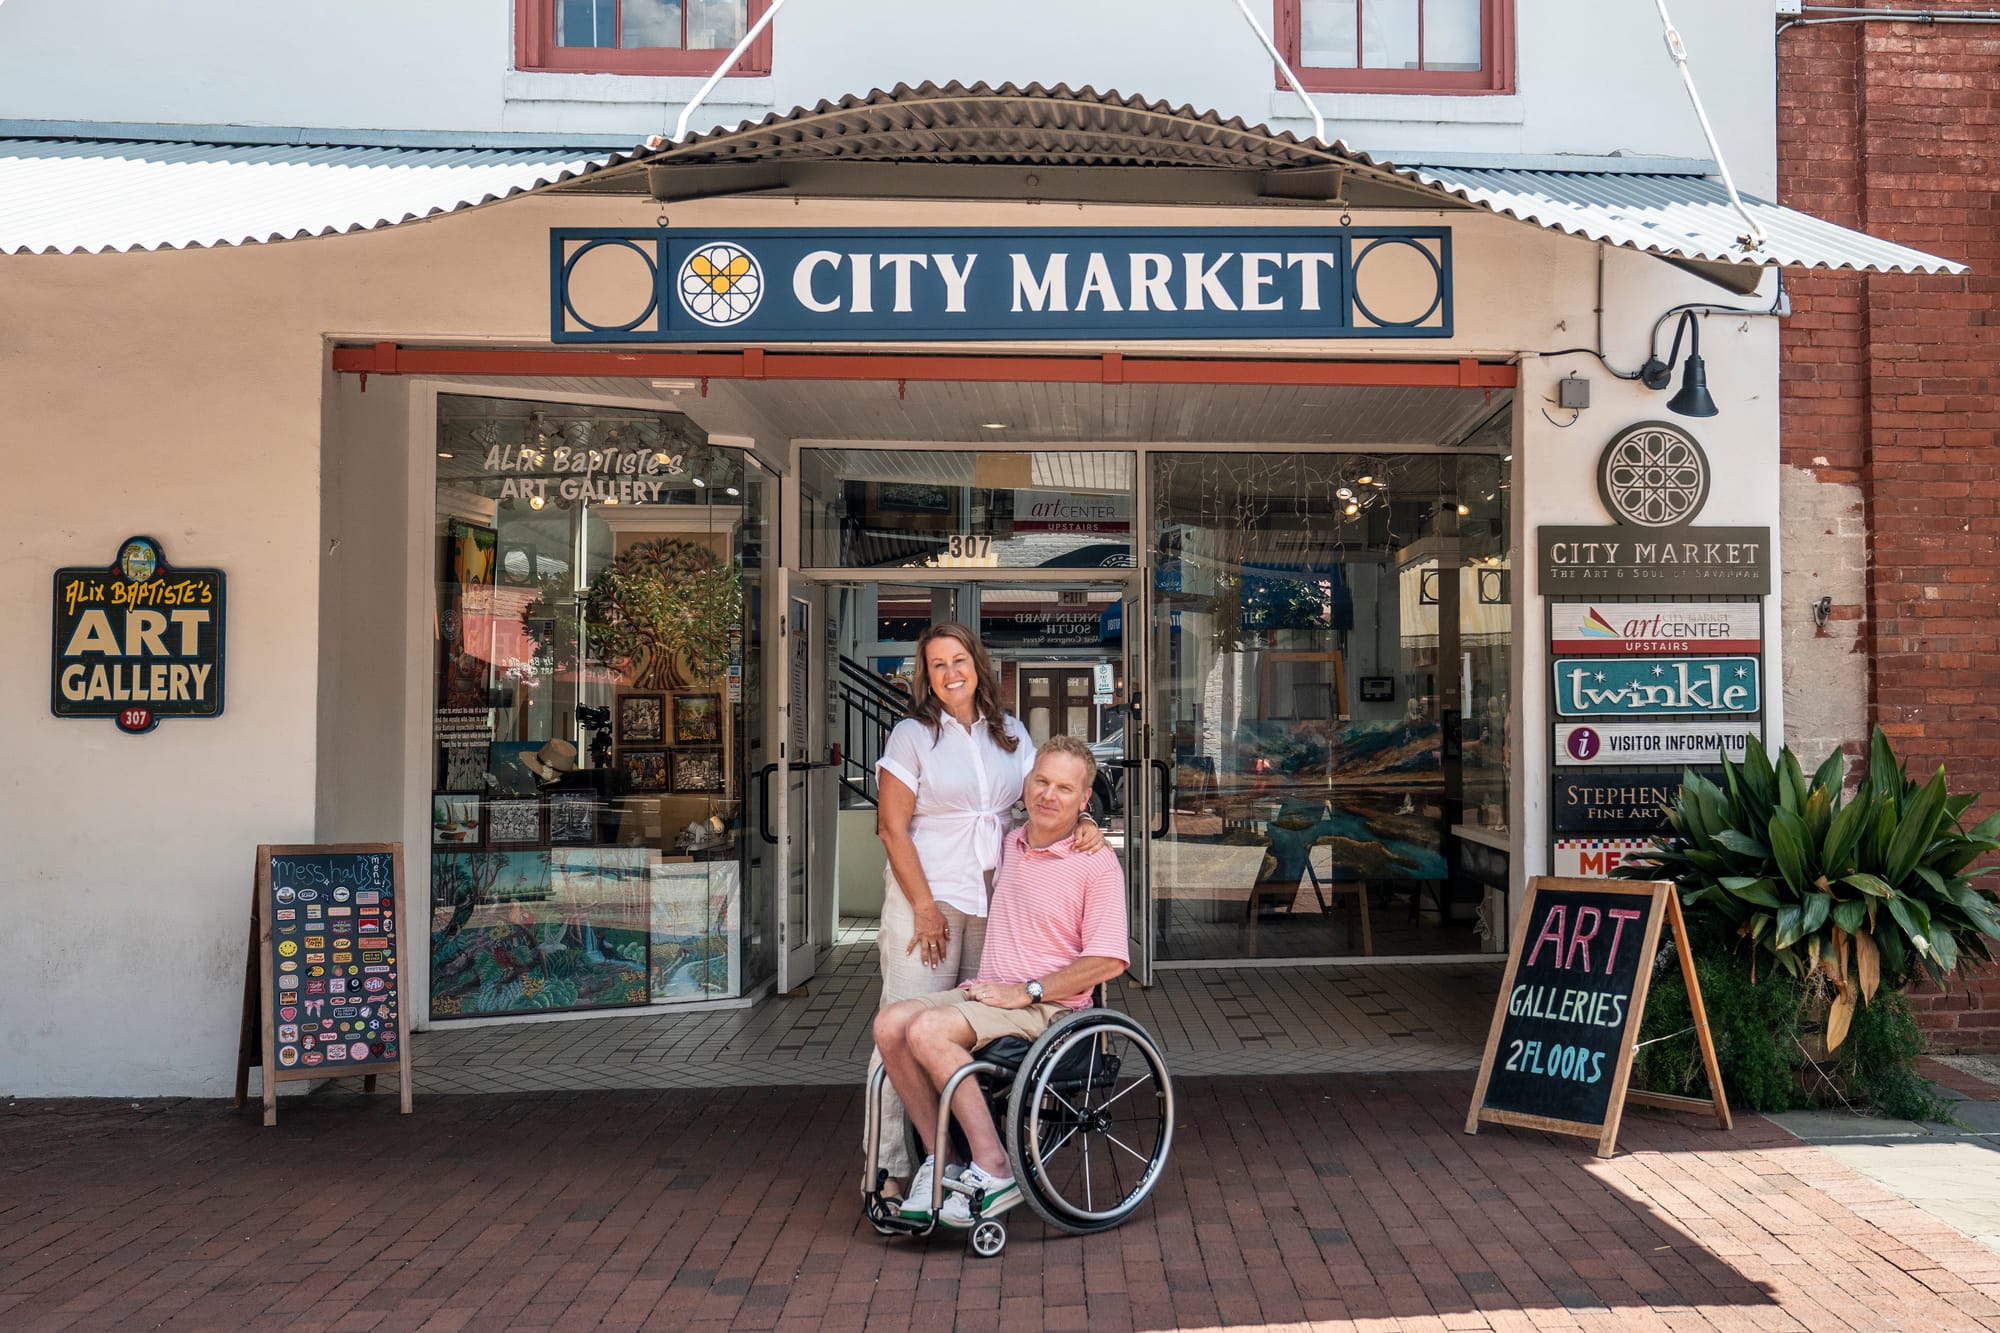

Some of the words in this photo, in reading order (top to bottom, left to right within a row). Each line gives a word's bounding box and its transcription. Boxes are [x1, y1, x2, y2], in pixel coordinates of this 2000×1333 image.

[792, 250, 978, 313] CITY
[1009, 252, 1335, 313] MARKET
[500, 478, 549, 499] ART
[559, 479, 664, 501] GALLERY
[1048, 523, 1099, 531] UPSTAIRS
[950, 535, 991, 559] 307
[1550, 543, 1620, 564] CITY
[1635, 543, 1759, 564] MARKET
[64, 609, 210, 656] ART
[1625, 642, 1689, 651] UPSTAIRS
[61, 663, 212, 701] GALLERY
[1566, 663, 1748, 710] twinkle
[126, 711, 147, 725] 307
[1610, 735, 1660, 751] VISITOR
[1567, 785, 1668, 806] STEPHEN
[1588, 808, 1624, 819] FINE
[1629, 808, 1661, 818] ART
[1526, 904, 1641, 976] ART
[1509, 983, 1627, 1028] GALLERIES
